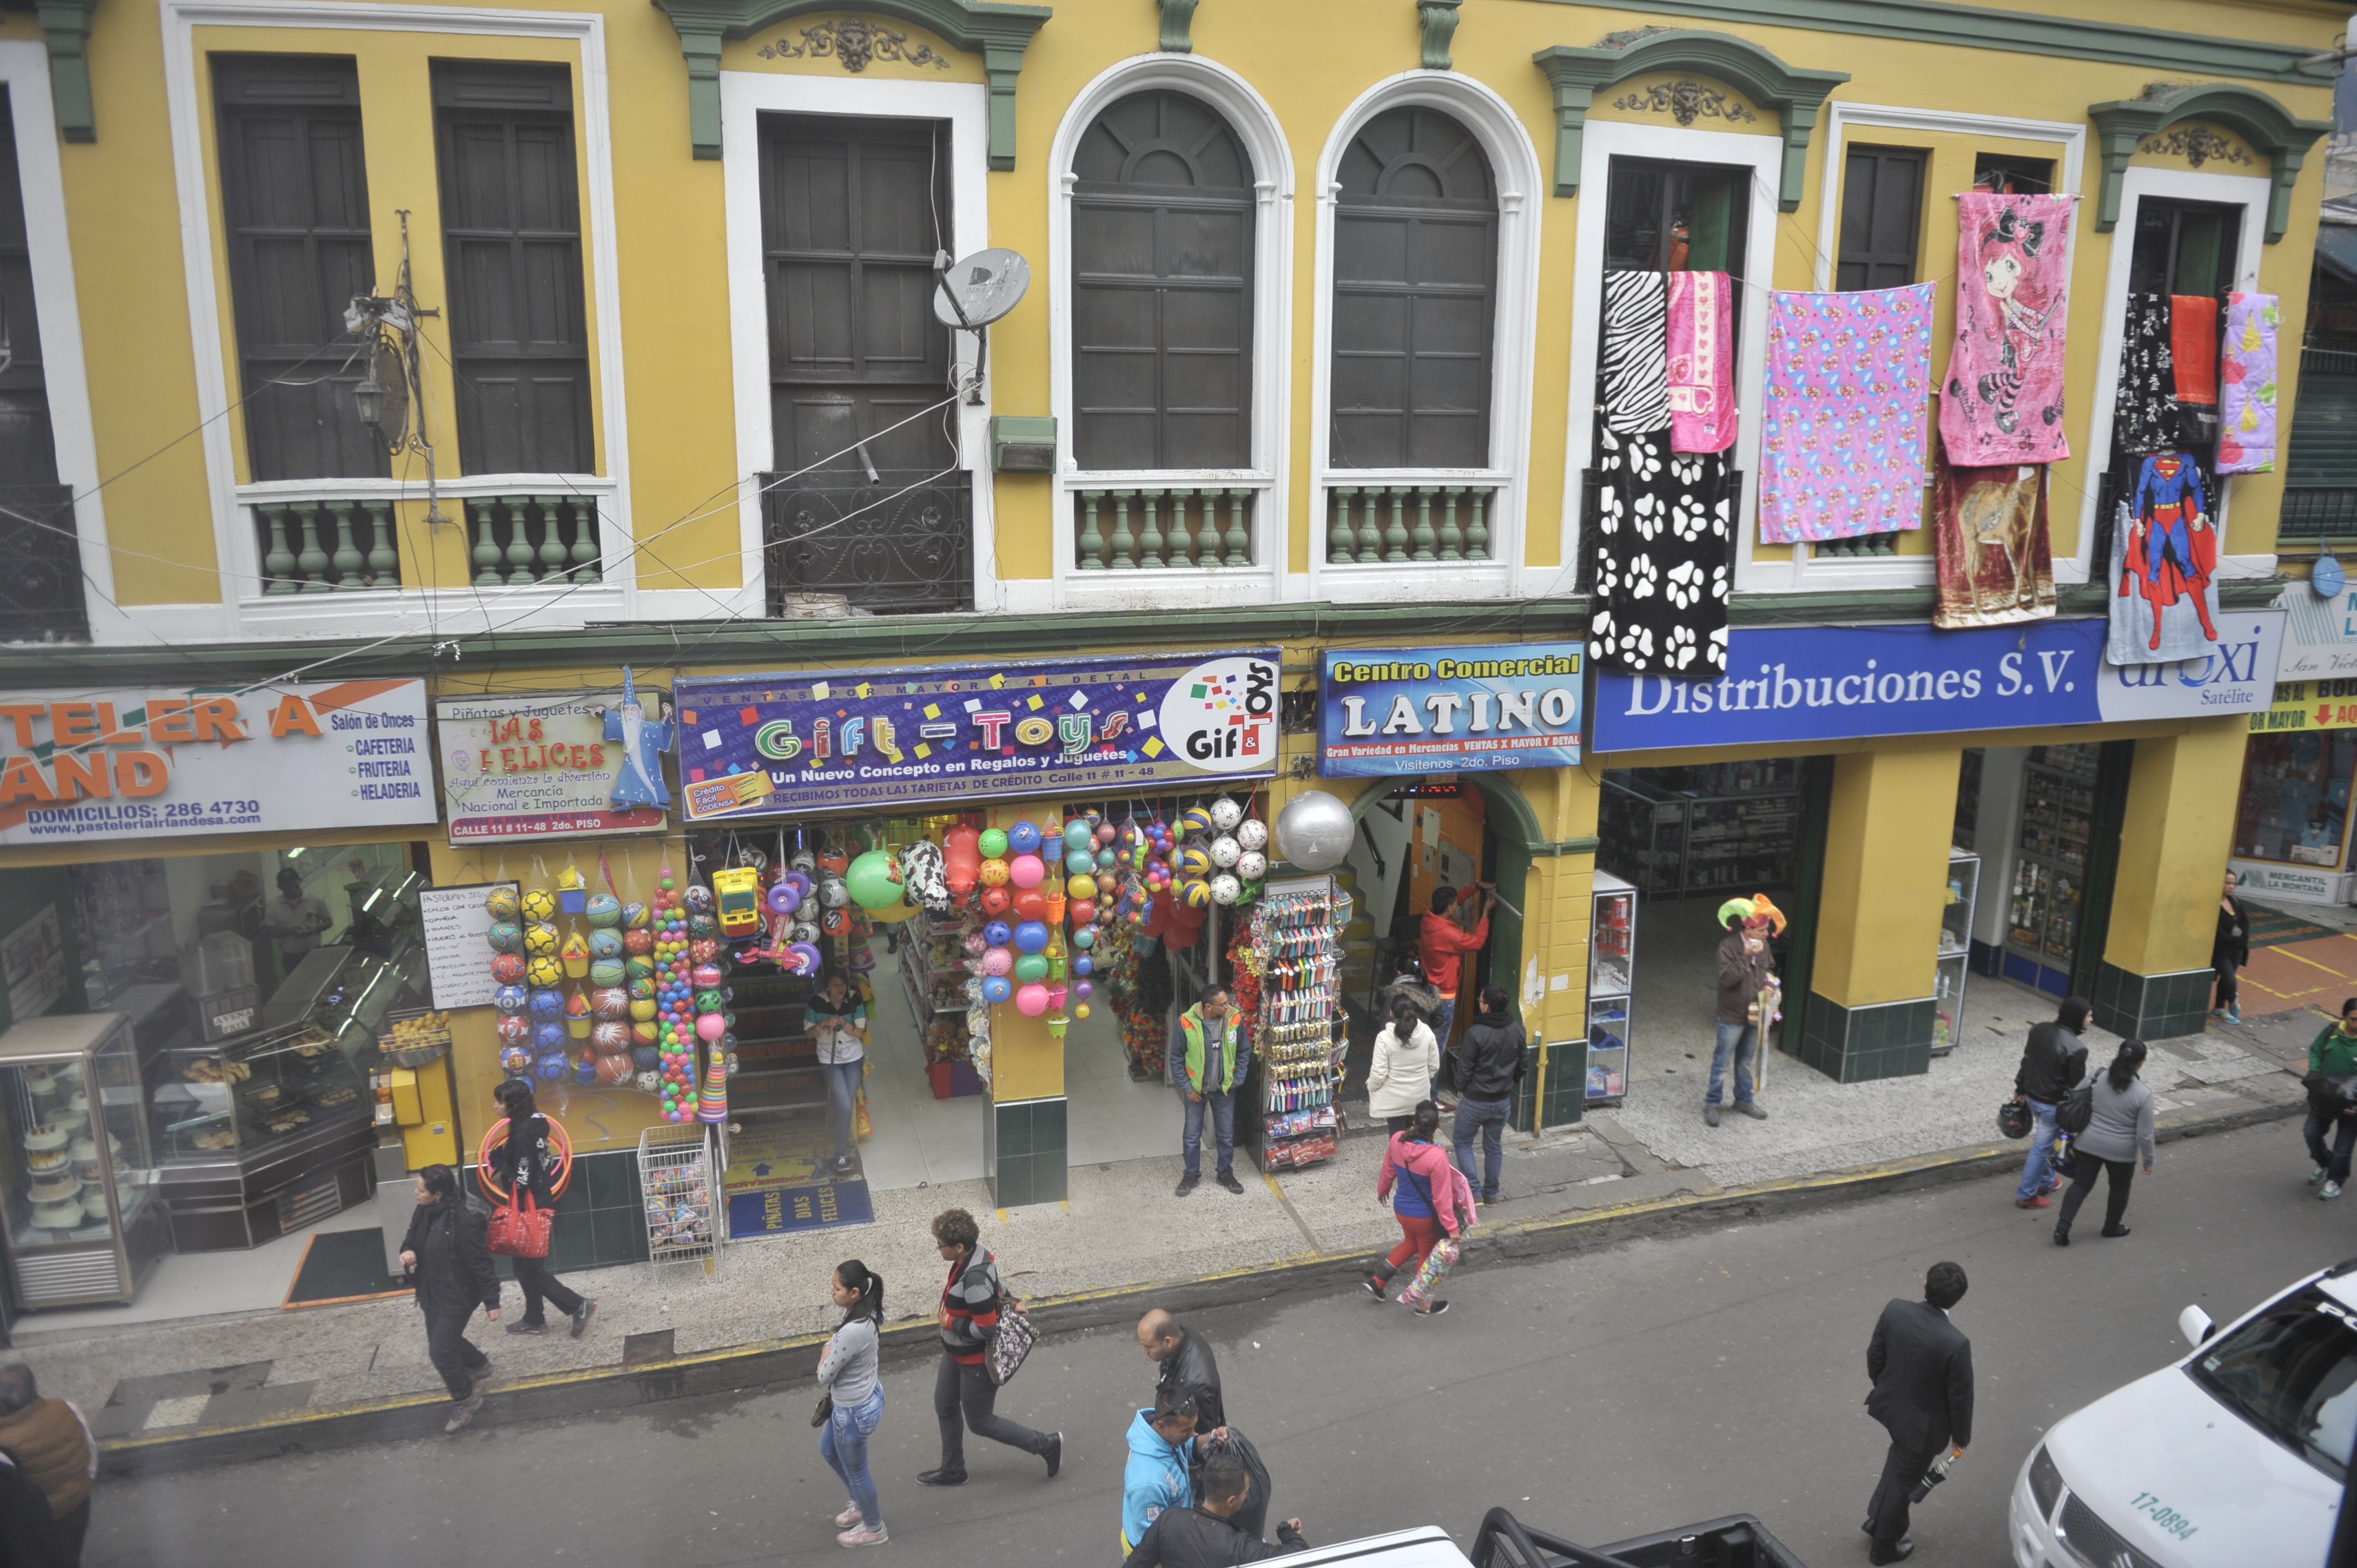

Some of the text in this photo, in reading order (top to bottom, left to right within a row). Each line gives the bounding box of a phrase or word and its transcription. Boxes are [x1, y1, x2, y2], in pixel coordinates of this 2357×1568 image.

[1332, 653, 1581, 682] Centro Comercial
[702, 691, 806, 705] VENTAS
[829, 688, 874, 698] POR
[896, 682, 979, 694] MAYOR
[1073, 672, 1146, 684] DETAL
[1624, 651, 2075, 716] Distribuciones S.V.
[2200, 689, 2253, 706] Satélite
[331, 712, 414, 731] Salón de Onces
[452, 704, 589, 720] Piñatas y Juguetes
[1341, 688, 1576, 736] LATINO
[2267, 710, 2306, 729] MAYOR
[755, 715, 896, 761] Gift
[971, 711, 1128, 755] Toys
[356, 737, 415, 756] CAFETERIA
[1326, 747, 1349, 757] Gran
[1351, 745, 1392, 756] Variedad
[1464, 740, 1498, 751] VENTAS
[1501, 739, 1508, 749] X
[1511, 737, 1542, 749] MAYOR
[1543, 737, 1550, 746] Y
[1552, 735, 1579, 746] DETAL
[358, 760, 411, 778] FRUTERIA
[773, 750, 1127, 783] Un Nuevo Concepto en Regalos y Juguetes
[1395, 755, 1520, 771] Visitenos 2do. Piso
[483, 776, 539, 787] comienza
[542, 772, 553, 784] la
[558, 771, 610, 783] diversión
[774, 789, 840, 803] RECIBIMOS
[843, 787, 883, 798] TODAS
[887, 785, 908, 796] LAS
[911, 781, 966, 793] TARJETAS
[973, 779, 989, 789] DE
[991, 775, 1042, 788] CRÉDITO
[1049, 772, 1083, 783] Calle
[1087, 772, 1096, 780] 11
[1100, 770, 1110, 779] #
[1114, 770, 1124, 778] 11
[1138, 767, 1154, 776] 48
[360, 782, 421, 801] HELADERIA
[496, 785, 563, 799] Mercancía
[693, 785, 725, 797] Crédito
[696, 794, 717, 806] Fácil
[28, 800, 259, 824] DOMICILIOS: 286 4730
[461, 795, 603, 813] Nacional e Importada
[696, 799, 735, 813] CODENSA
[29, 814, 260, 834] www.pasteleriairlandesa.com
[454, 819, 601, 835] CALLE 11 # 11-48 2do. PISO
[459, 817, 489, 826] VENTAS
[524, 814, 550, 823] MAYOR
[794, 1196, 812, 1219] DIAS
[819, 1187, 838, 1222] FELICES
[2130, 1492, 2199, 1541] 17-0894
